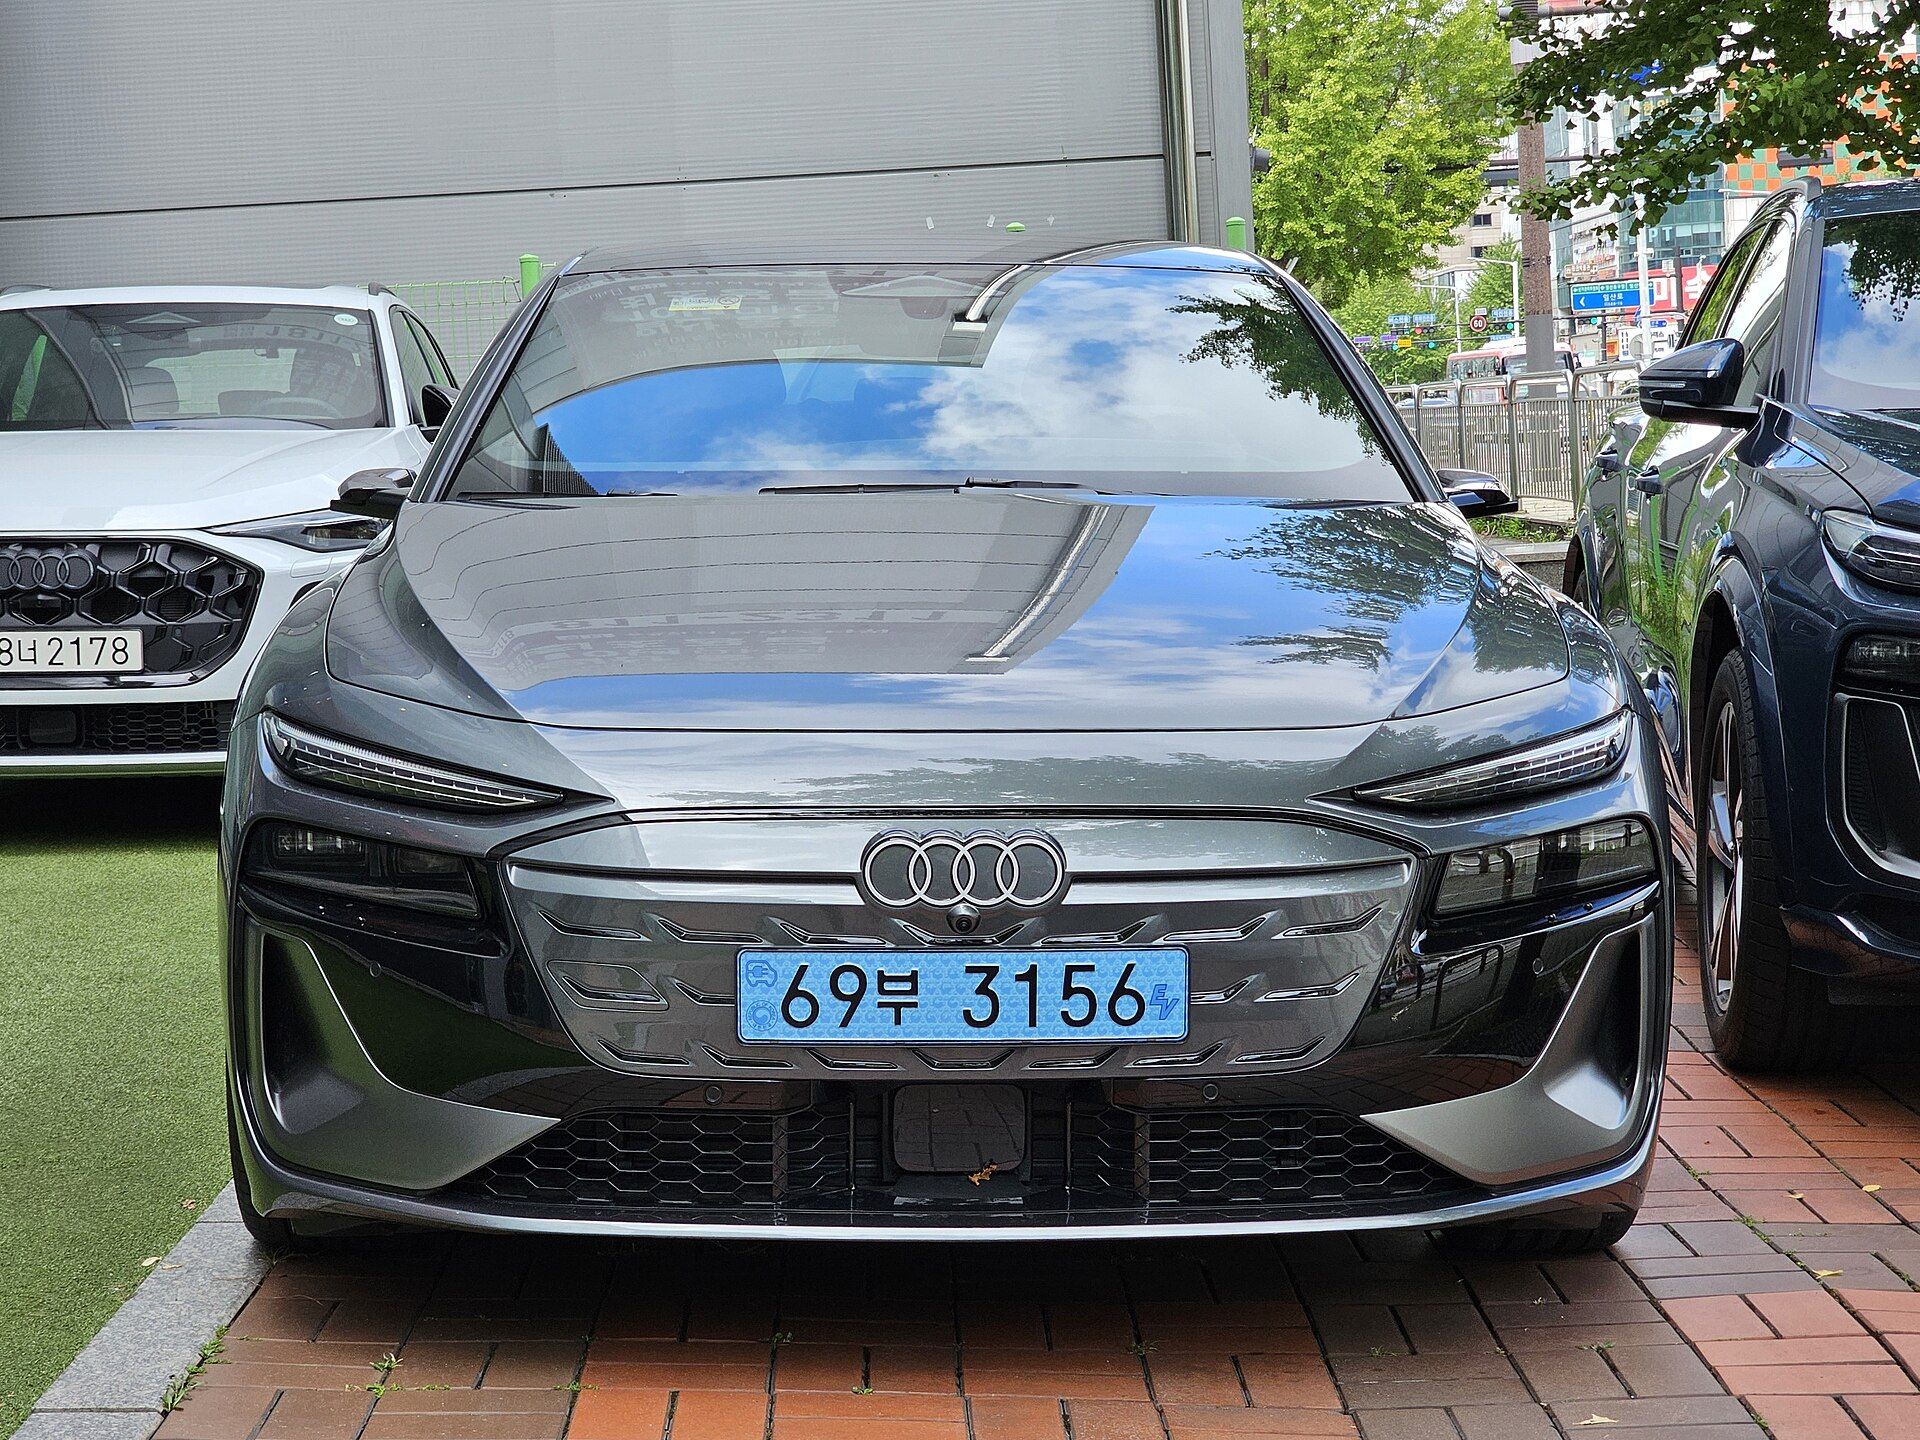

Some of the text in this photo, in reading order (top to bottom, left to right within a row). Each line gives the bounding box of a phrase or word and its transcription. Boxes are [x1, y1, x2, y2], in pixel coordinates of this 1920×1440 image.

[1602, 293, 1624, 302] 일산로
[1473, 320, 1483, 328] 60
[47, 636, 129, 666] 2178
[780, 964, 920, 1029] 69부
[962, 962, 1147, 1028] 3156
[1149, 983, 1180, 1021] EV
